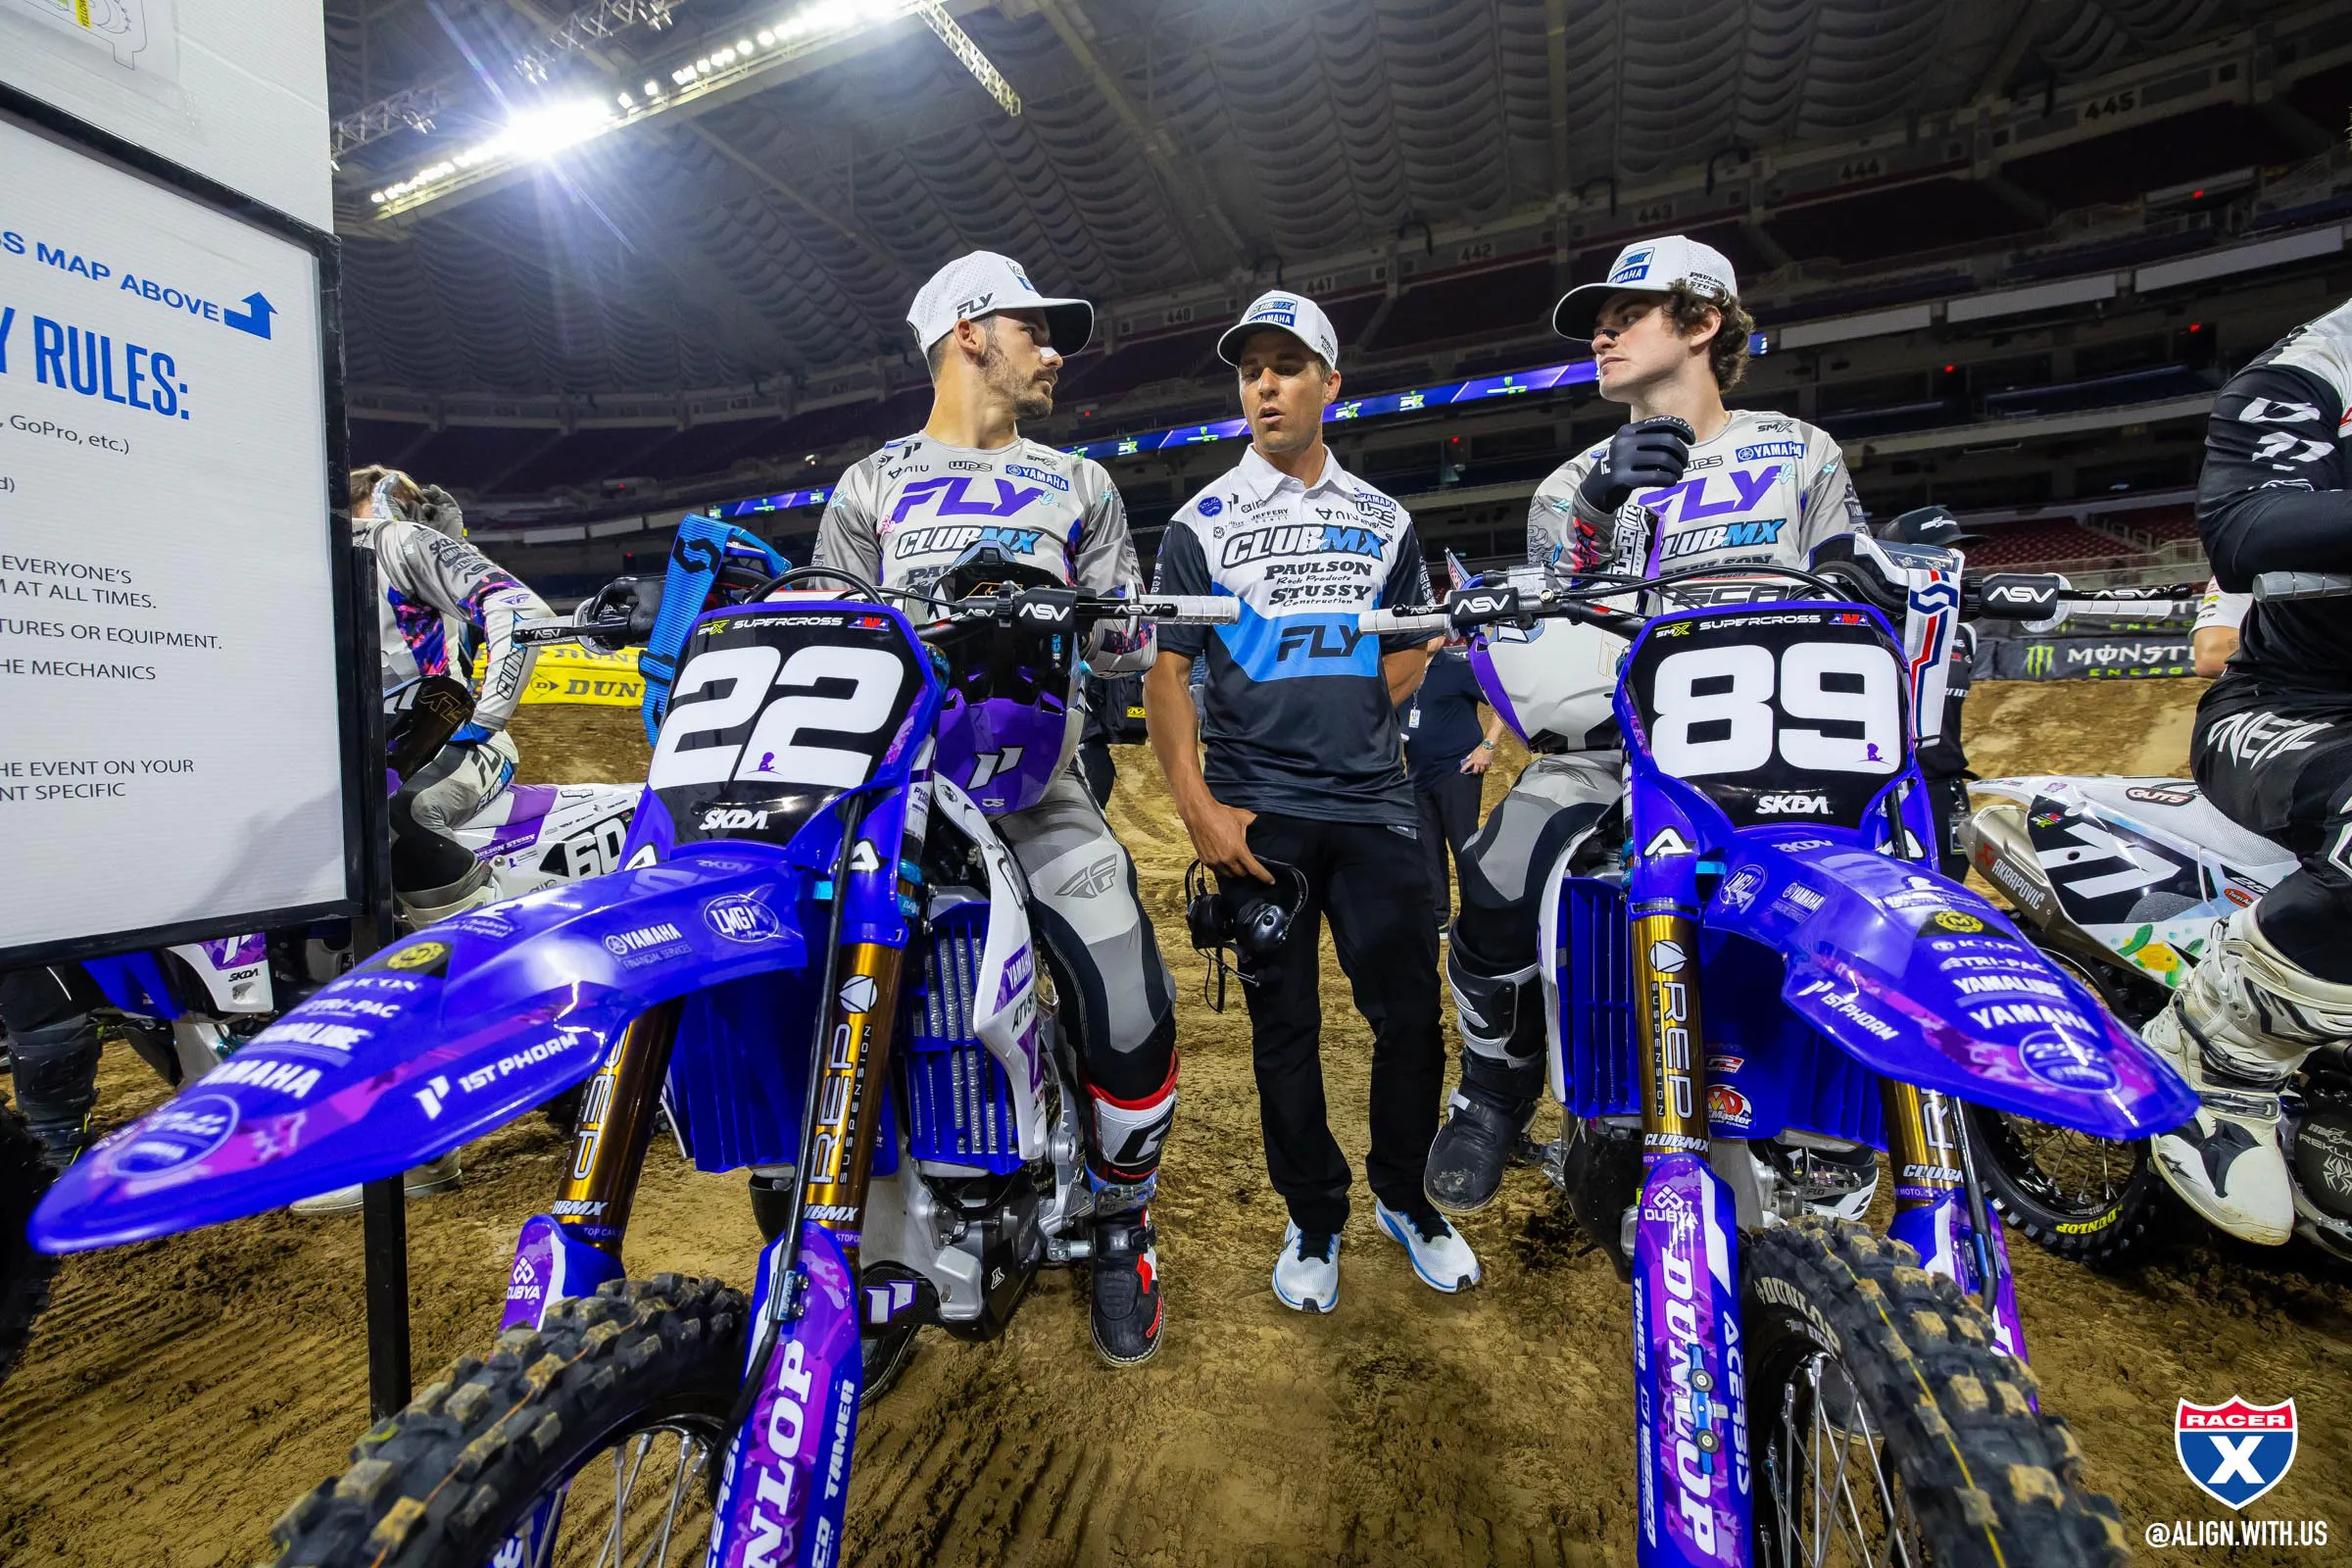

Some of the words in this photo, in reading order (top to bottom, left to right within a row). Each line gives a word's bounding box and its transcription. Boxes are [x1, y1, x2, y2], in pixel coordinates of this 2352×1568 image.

[2085, 91, 2135, 121] 445
[1461, 243, 1493, 262] 442
[37, 242, 111, 280] MAP
[121, 273, 220, 322] ABOVE
[956, 293, 993, 318] FLY
[1166, 307, 1191, 323] 440
[33, 315, 190, 420] RULES:
[10, 416, 83, 446] GoPro,
[88, 431, 130, 456] etc.)
[1757, 420, 1794, 434] SMX
[1022, 467, 1067, 490] YAMAHA
[892, 477, 1047, 523] FLY
[1638, 466, 1782, 522] FLY
[1222, 523, 1388, 568] CLUBMX
[1661, 518, 1787, 562] LUBMX
[2, 555, 132, 584] EVERYONE'S
[1264, 562, 1372, 580] PAULSON
[14, 580, 43, 597] AT
[49, 584, 88, 602] ALL
[92, 588, 157, 609] TIMES.
[1268, 585, 1372, 606] STUSSY
[1283, 595, 1352, 608] Construction
[1454, 594, 1510, 615] ASV
[1987, 586, 2055, 603] ASV
[2092, 589, 2158, 600] ASV
[965, 608, 995, 618] ASV
[1019, 603, 1070, 621] ASV
[1409, 606, 1436, 615] ASV
[71, 624, 101, 641] OR
[107, 627, 222, 650] EQUIPMENT.
[534, 628, 561, 639] ASV
[697, 619, 730, 636] SMX
[733, 616, 844, 630] SUPERCROSS
[1654, 621, 1692, 638] SMX
[1699, 614, 1821, 630] SUPERCROSS
[1277, 624, 1365, 662] FLY
[31, 660, 156, 680] MECHANICS
[564, 678, 649, 699] DUN
[647, 645, 905, 791] 22
[1651, 642, 1901, 778] 89
[30, 760, 98, 777] EVENT
[104, 760, 136, 775] ON
[140, 759, 195, 775] YOUR
[35, 782, 126, 801] SPECIFIC
[2129, 787, 2191, 805] GUTS
[1755, 795, 1835, 815] SKDA
[699, 808, 769, 830] SKDA
[564, 816, 627, 881] 60
[623, 923, 682, 950] YAMAHA
[228, 968, 260, 982] SKDA
[1838, 1004, 1900, 1041] PHORM
[1968, 1004, 2100, 1039] YAMAHA
[1651, 981, 1665, 1117] SUSPENSION
[1663, 981, 1694, 1119] REP
[458, 1064, 497, 1094] 1ST
[497, 1032, 580, 1076] PHORM
[808, 1022, 853, 1185] REP
[839, 1025, 871, 1184] SUSPENSION
[1644, 1133, 1710, 1153] CLUBMX
[551, 1200, 610, 1216] UBMX
[805, 1204, 858, 1222] UBMX
[2055, 1206, 2118, 1235] DUNLOP
